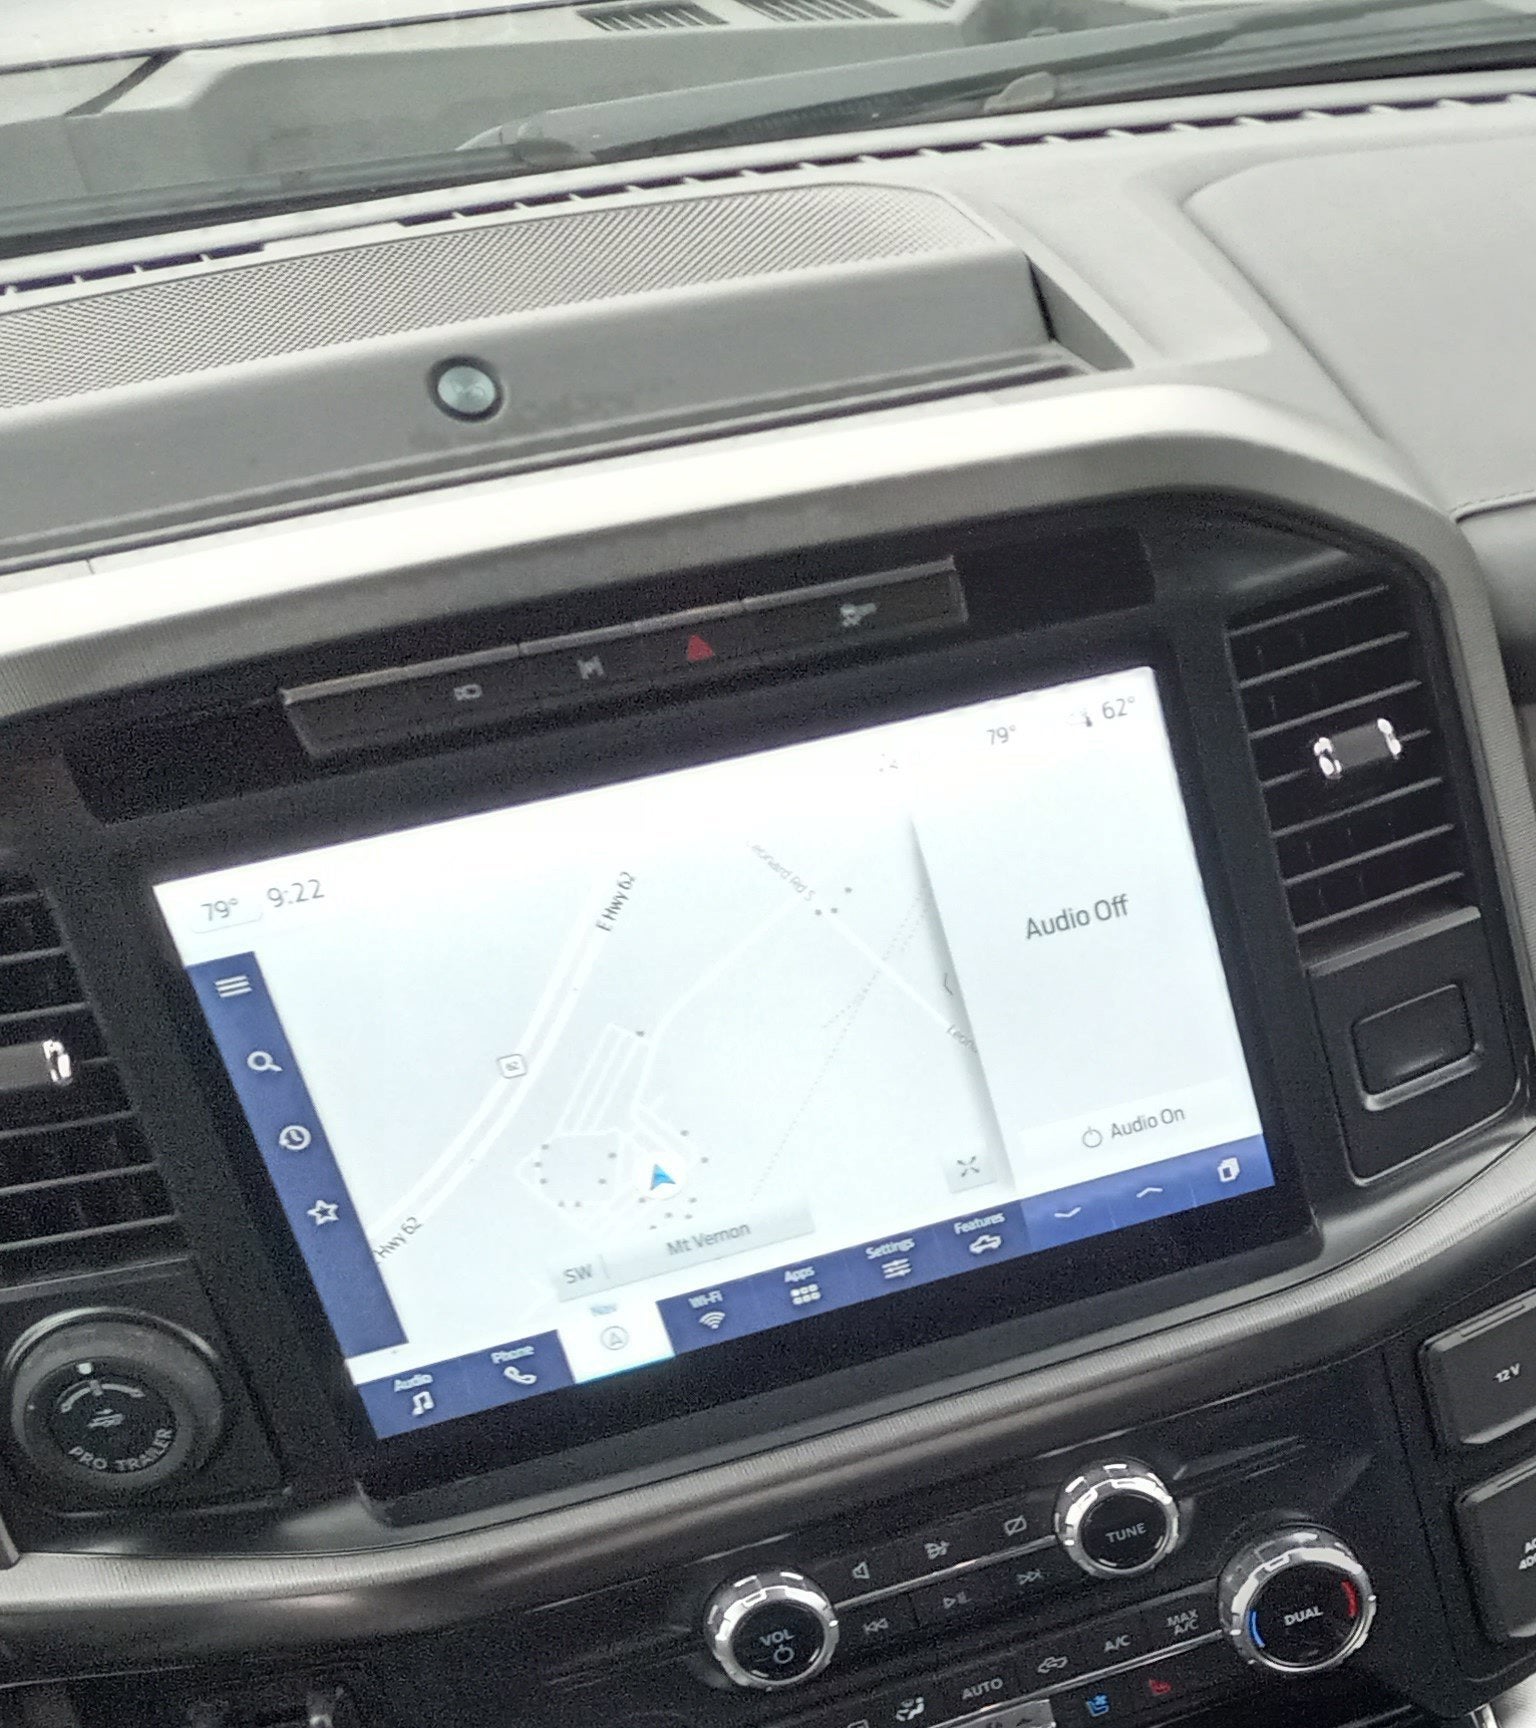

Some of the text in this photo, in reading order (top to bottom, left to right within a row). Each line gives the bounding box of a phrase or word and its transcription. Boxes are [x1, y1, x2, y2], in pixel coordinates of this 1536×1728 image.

[267, 879, 325, 907] 9:22
[601, 890, 630, 921] Hwy
[616, 871, 636, 890] 62
[1025, 894, 1130, 939] Audio Off
[1111, 1108, 1185, 1138] Audio On
[401, 1216, 423, 1235] 62
[954, 1212, 1005, 1235] Features
[667, 1224, 751, 1255] Mt Vernon
[866, 1236, 915, 1260] Settings
[564, 1264, 593, 1284] SW
[784, 1265, 815, 1284] Apps
[491, 1344, 535, 1364] Phone
[394, 1374, 433, 1393] Audio
[69, 1427, 173, 1471] PRO TRAILER
[1105, 1522, 1148, 1543] TUNE
[1166, 1609, 1199, 1628] MAX
[1283, 1606, 1324, 1627] DUAL
[759, 1628, 795, 1647] VOL
[1174, 1619, 1198, 1636] A/C
[1104, 1635, 1131, 1652] A/C
[962, 1678, 1004, 1699] AUTO
